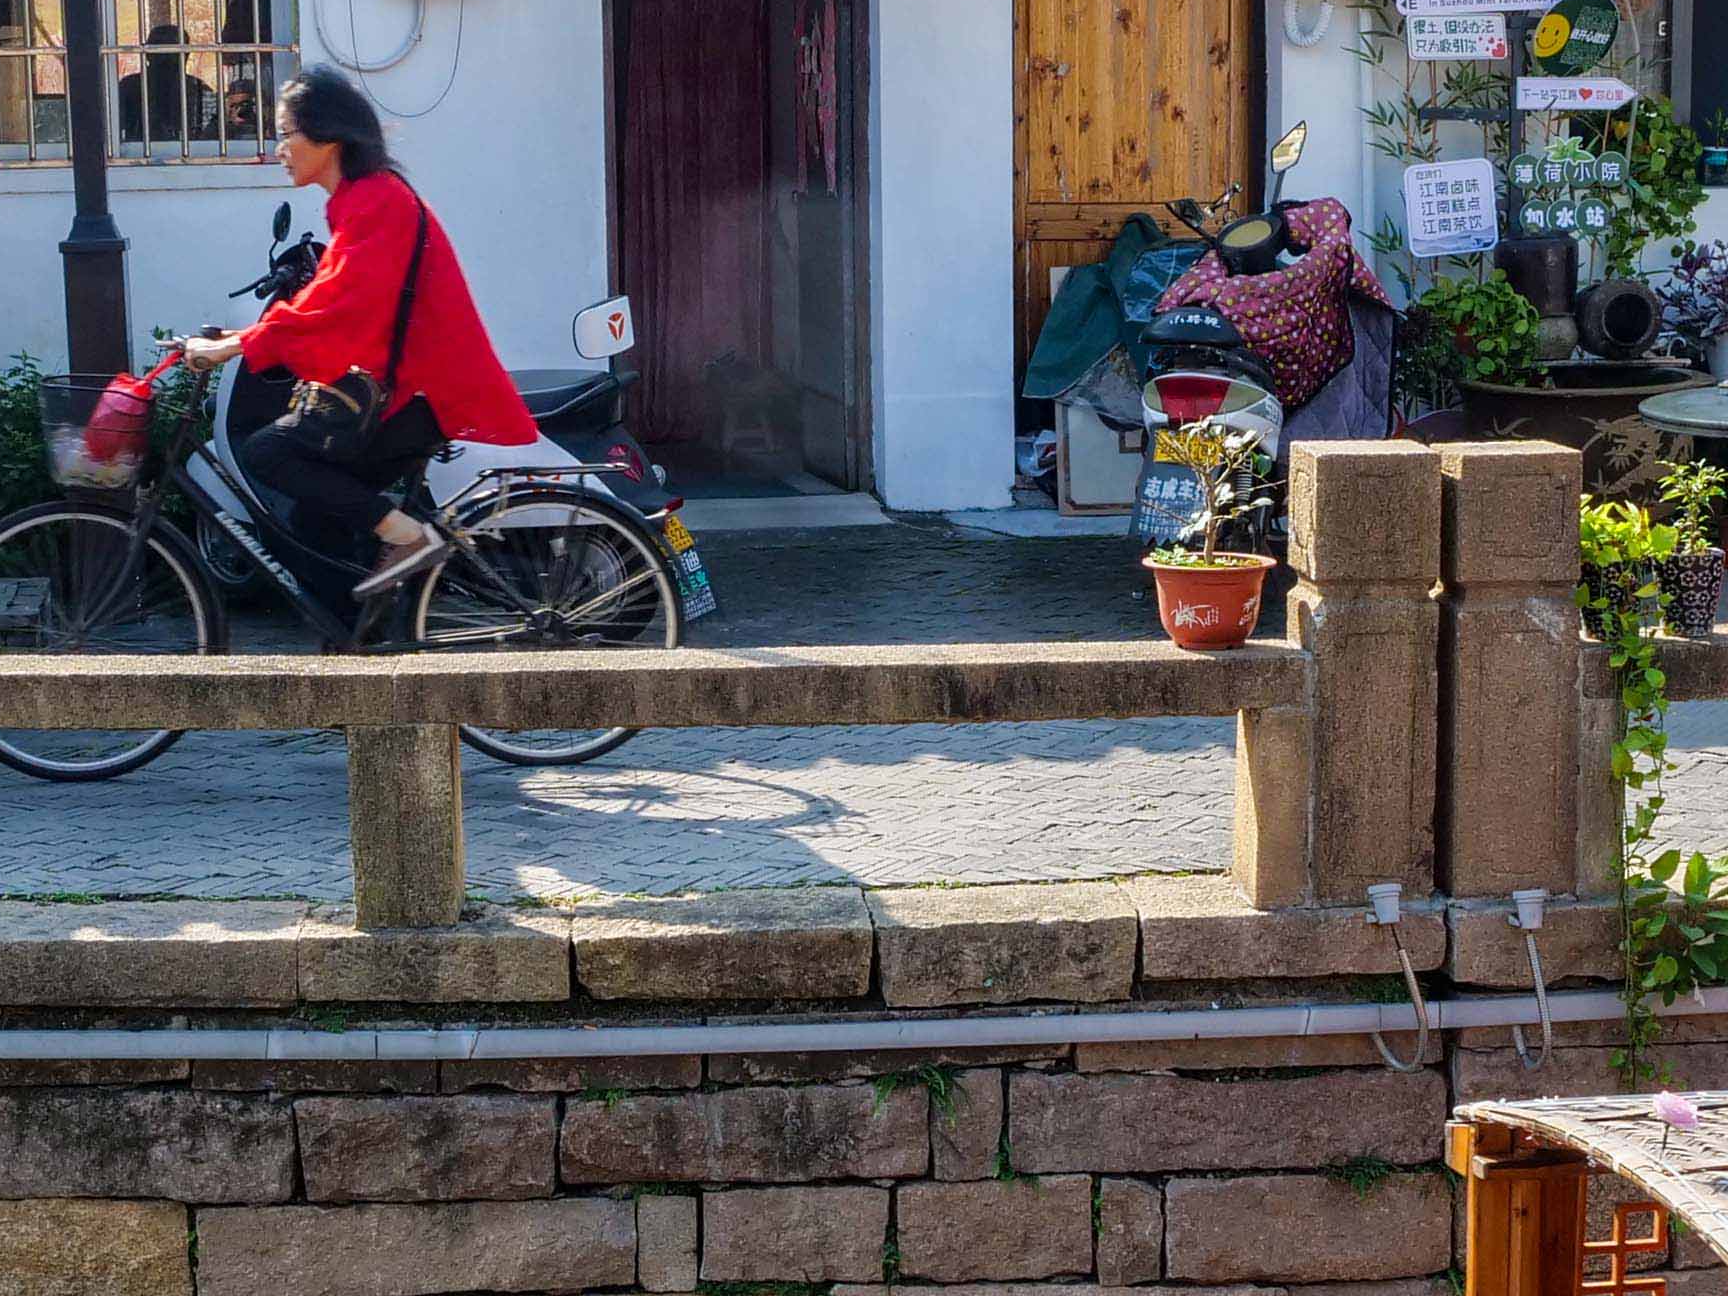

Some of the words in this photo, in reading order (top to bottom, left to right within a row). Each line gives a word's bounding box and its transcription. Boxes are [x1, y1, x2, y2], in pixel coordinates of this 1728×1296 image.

[1515, 163, 1621, 182] 薄荷小院
[1419, 178, 1480, 199] 江南卤味
[1422, 196, 1481, 217] 江南糕点
[1423, 215, 1483, 235] 江南茶饮
